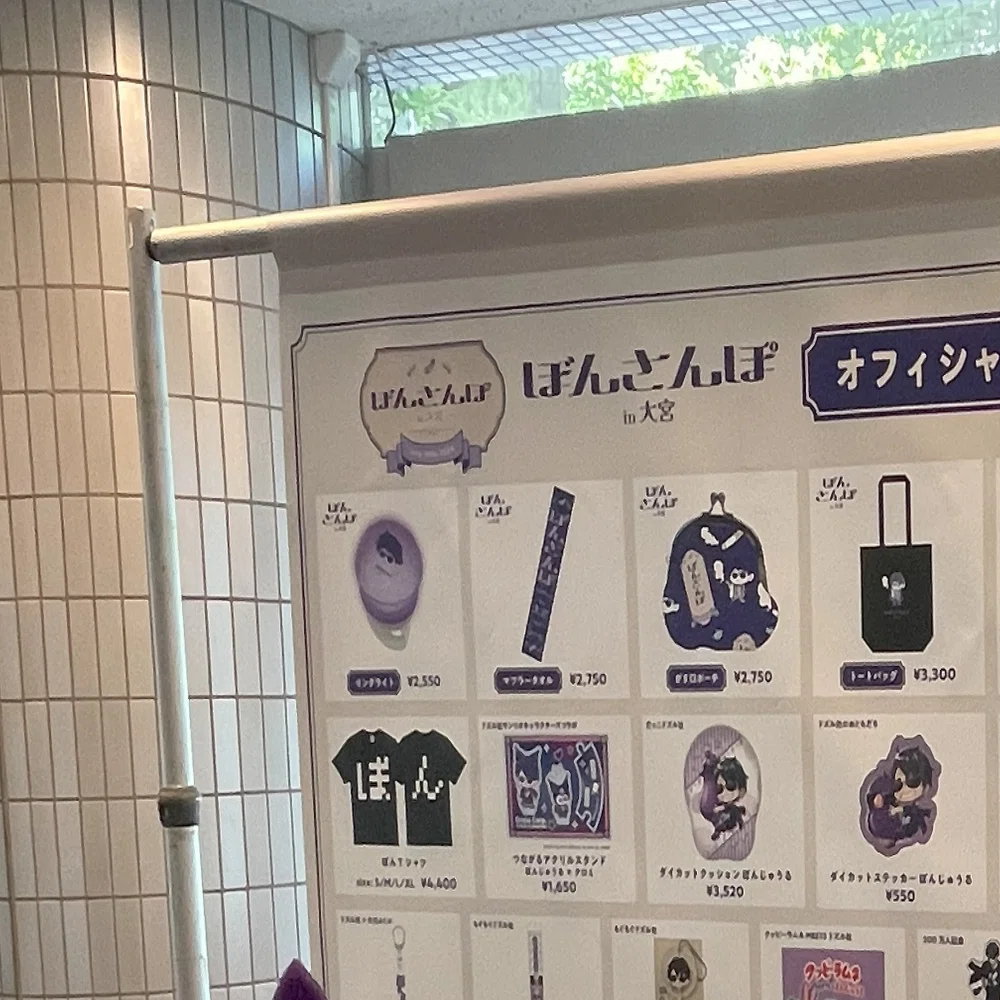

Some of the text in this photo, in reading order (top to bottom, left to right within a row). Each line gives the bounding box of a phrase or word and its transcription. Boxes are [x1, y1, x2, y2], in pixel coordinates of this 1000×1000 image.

[522, 340, 779, 398] ぼんさんぽ
[639, 399, 676, 424] 大宮
[569, 673, 607, 687] ¥2,750
[734, 670, 773, 684] ¥2,750
[914, 668, 956, 682] ¥3,300
[421, 877, 457, 890] ¥4,400
[541, 881, 577, 893] ¥1,650
[707, 885, 744, 898] ¥3,520
[886, 890, 915, 902] ¥550
